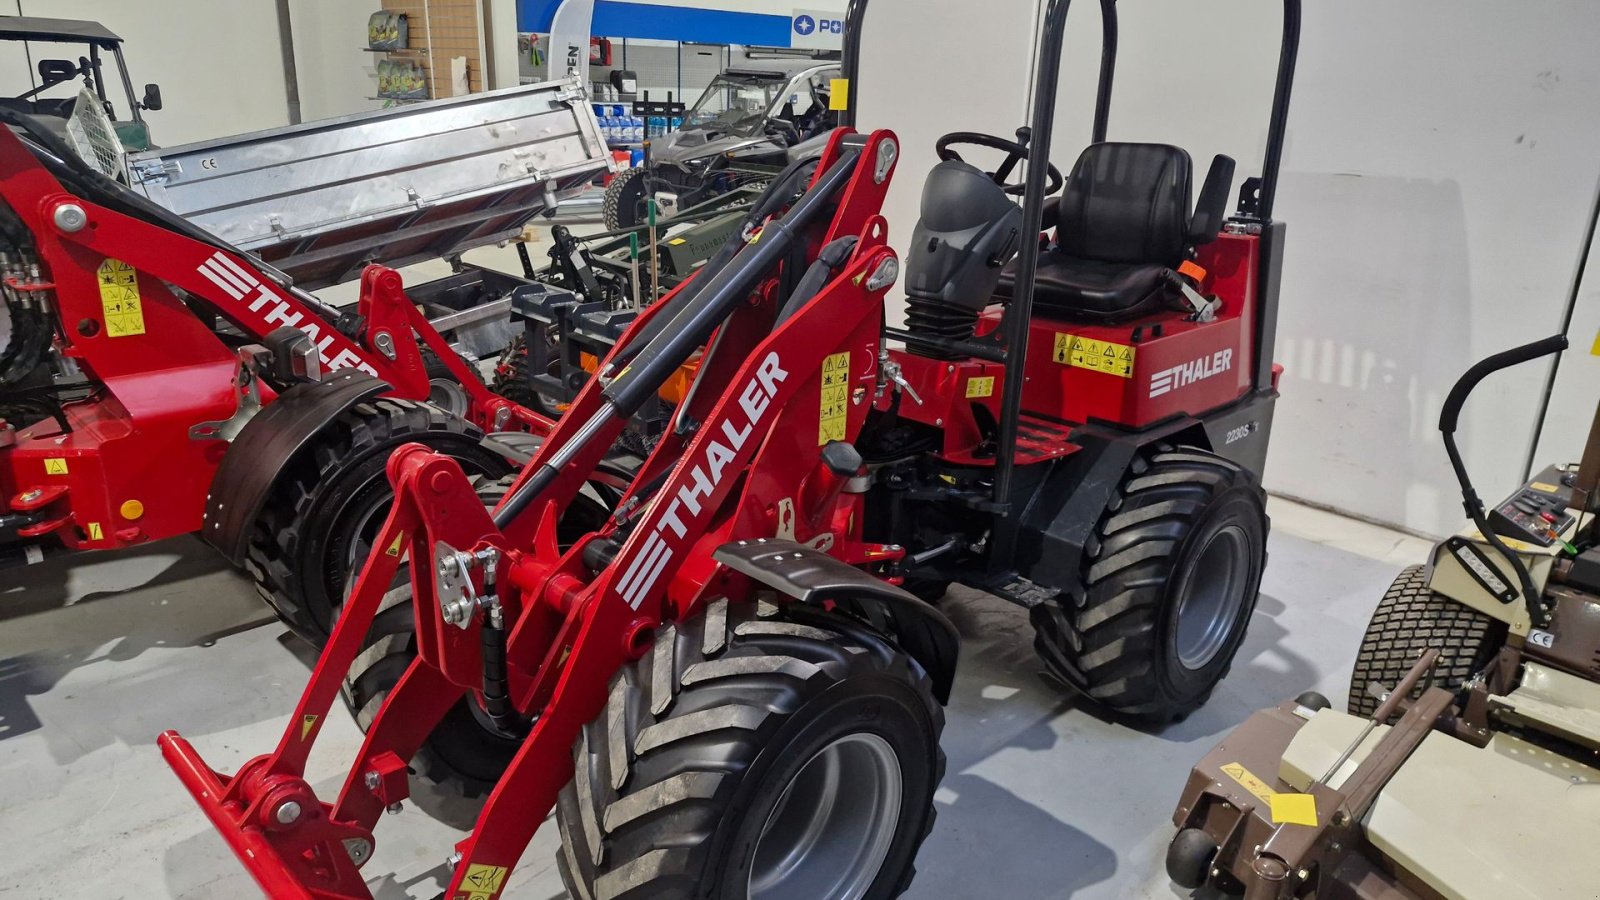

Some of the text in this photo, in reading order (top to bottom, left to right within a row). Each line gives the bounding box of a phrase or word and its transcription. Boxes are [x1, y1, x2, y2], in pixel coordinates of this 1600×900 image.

[202, 158, 217, 170] CE
[248, 284, 379, 379] THALE
[1172, 348, 1233, 390] THALER
[656, 351, 789, 540] THALER
[1533, 632, 1551, 646] CE
